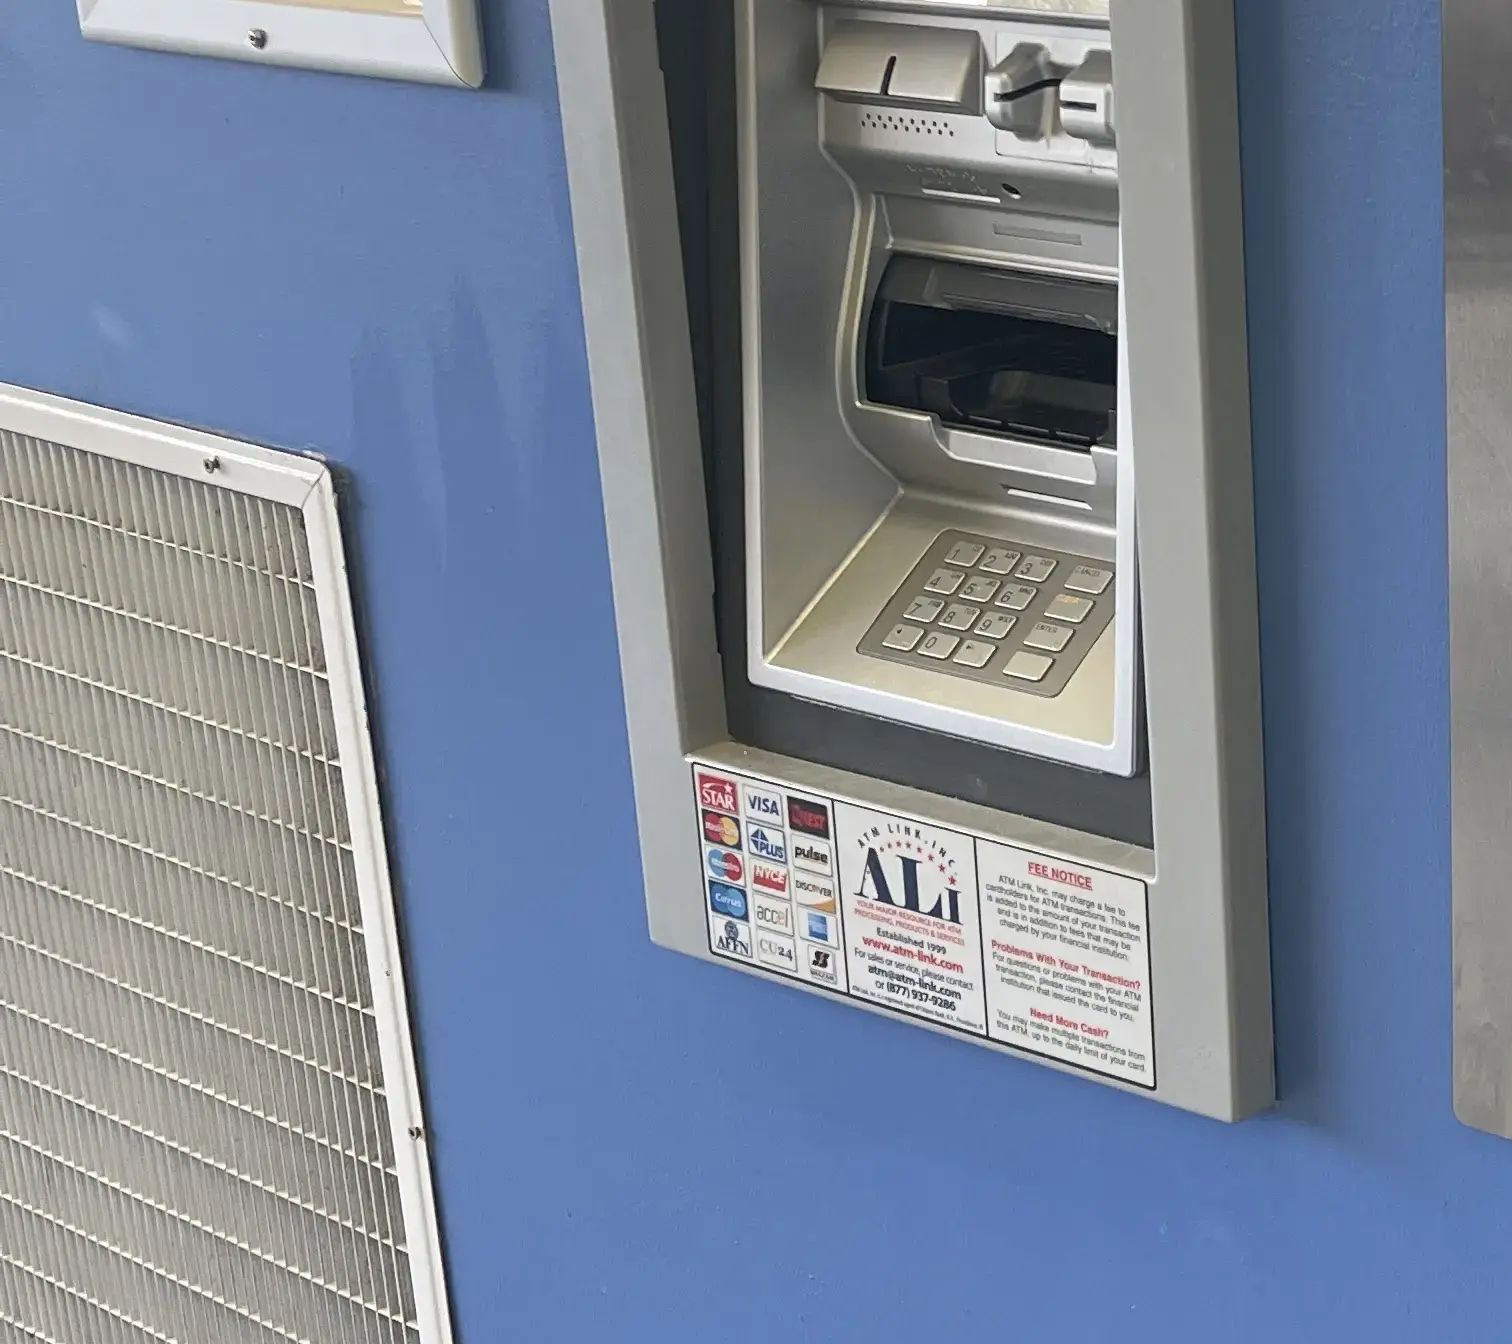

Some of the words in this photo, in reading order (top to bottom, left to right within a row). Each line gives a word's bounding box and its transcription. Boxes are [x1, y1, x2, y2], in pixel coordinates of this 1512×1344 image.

[952, 548, 960, 561] 1
[983, 556, 996, 568] 2
[1020, 563, 1032, 574] 3
[930, 575, 938, 587] 4
[964, 582, 977, 595] 5
[914, 602, 922, 613] 7
[1001, 591, 1011, 602] 6
[946, 611, 955, 623] 8
[980, 619, 991, 631] 9
[926, 636, 937, 648] 0
[702, 787, 734, 810] STAR
[748, 793, 778, 815] VISA
[760, 840, 783, 858] PLUS
[794, 841, 828, 866] pulse
[754, 865, 784, 884] NYCE
[1028, 862, 1049, 878] FEE
[1051, 867, 1092, 888] NOTICE
[985, 881, 1028, 901] cardholders
[1029, 893, 1039, 904] for
[1041, 896, 1058, 909] ATM
[1110, 916, 1126, 928] This
[1128, 921, 1139, 932] fee
[998, 874, 1015, 886] ATM
[1051, 889, 1067, 902] may
[1069, 893, 1094, 909] charge
[1104, 903, 1115, 914] fee
[1118, 907, 1125, 917] to
[757, 905, 788, 928] accel
[717, 934, 748, 954] AFFN
[876, 926, 924, 948] Established
[926, 941, 946, 955] 1999
[862, 933, 963, 974] www.atm-link.com
[991, 939, 1033, 959] Problems
[1036, 952, 1056, 966] With
[1058, 958, 1078, 973] Your
[1083, 965, 1140, 991] Transaction?
[854, 947, 865, 958] For
[867, 950, 884, 964] sales
[884, 956, 892, 967] or
[921, 966, 944, 983] please
[945, 974, 972, 991] contact
[992, 950, 1004, 962] For
[1006, 955, 1040, 973] questions
[1042, 965, 1050, 975] or
[1052, 968, 1086, 987] problems
[1088, 979, 1103, 991] with
[1104, 984, 1121, 998] your
[1123, 989, 1141, 1002] ATM
[867, 963, 961, 1001] atm@atm-link.com
[874, 979, 884, 990] or
[886, 981, 909, 998] (877)
[911, 988, 955, 1012] 937-9286
[1000, 974, 1034, 992] institution
[1036, 985, 1049, 996] that
[1051, 989, 1076, 1005] issued
[1078, 997, 1088, 1008] the
[1091, 1001, 1107, 1014] card
[1109, 1007, 1116, 1017] to
[1039, 975, 1062, 991] please
[1065, 983, 1092, 999] contact
[1094, 992, 1105, 1003] the
[1107, 996, 1138, 1013] financial
[1030, 1006, 1052, 1022] Need
[1055, 1014, 1078, 1030] More
[1080, 1022, 1108, 1040] Cash?
[997, 1008, 1010, 1020] You
[1013, 1014, 1027, 1027] may
[1029, 1018, 1049, 1032] make
[1051, 1025, 1079, 1042] multiple
[1081, 1034, 1125, 1056] transactions
[1128, 1049, 1144, 1062] from
